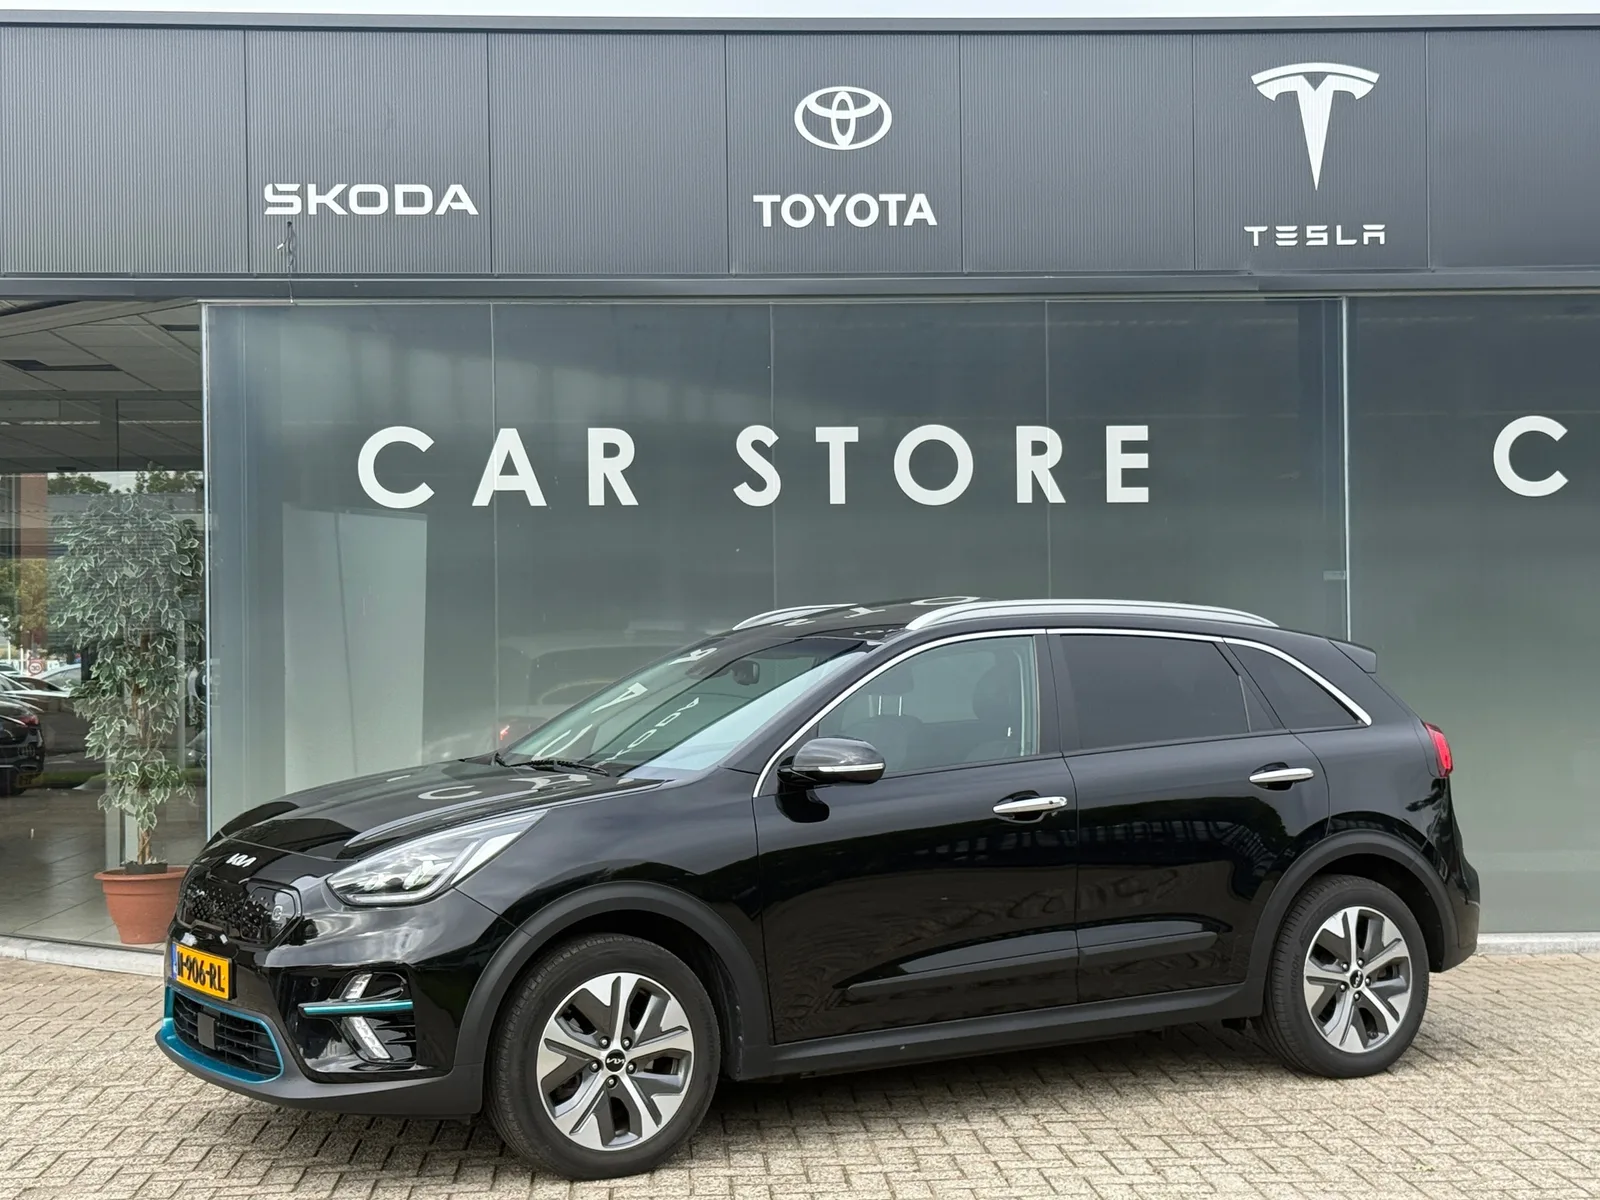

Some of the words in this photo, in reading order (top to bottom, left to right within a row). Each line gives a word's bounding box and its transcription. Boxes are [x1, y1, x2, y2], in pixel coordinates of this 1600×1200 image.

[264, 182, 479, 216] SKODA
[753, 192, 937, 228] TOYOTA
[1243, 224, 1387, 247] TESLA
[357, 425, 639, 508] CAR
[733, 423, 1151, 507] STORE
[1493, 415, 1568, 498] C
[225, 852, 257, 868] KIA
